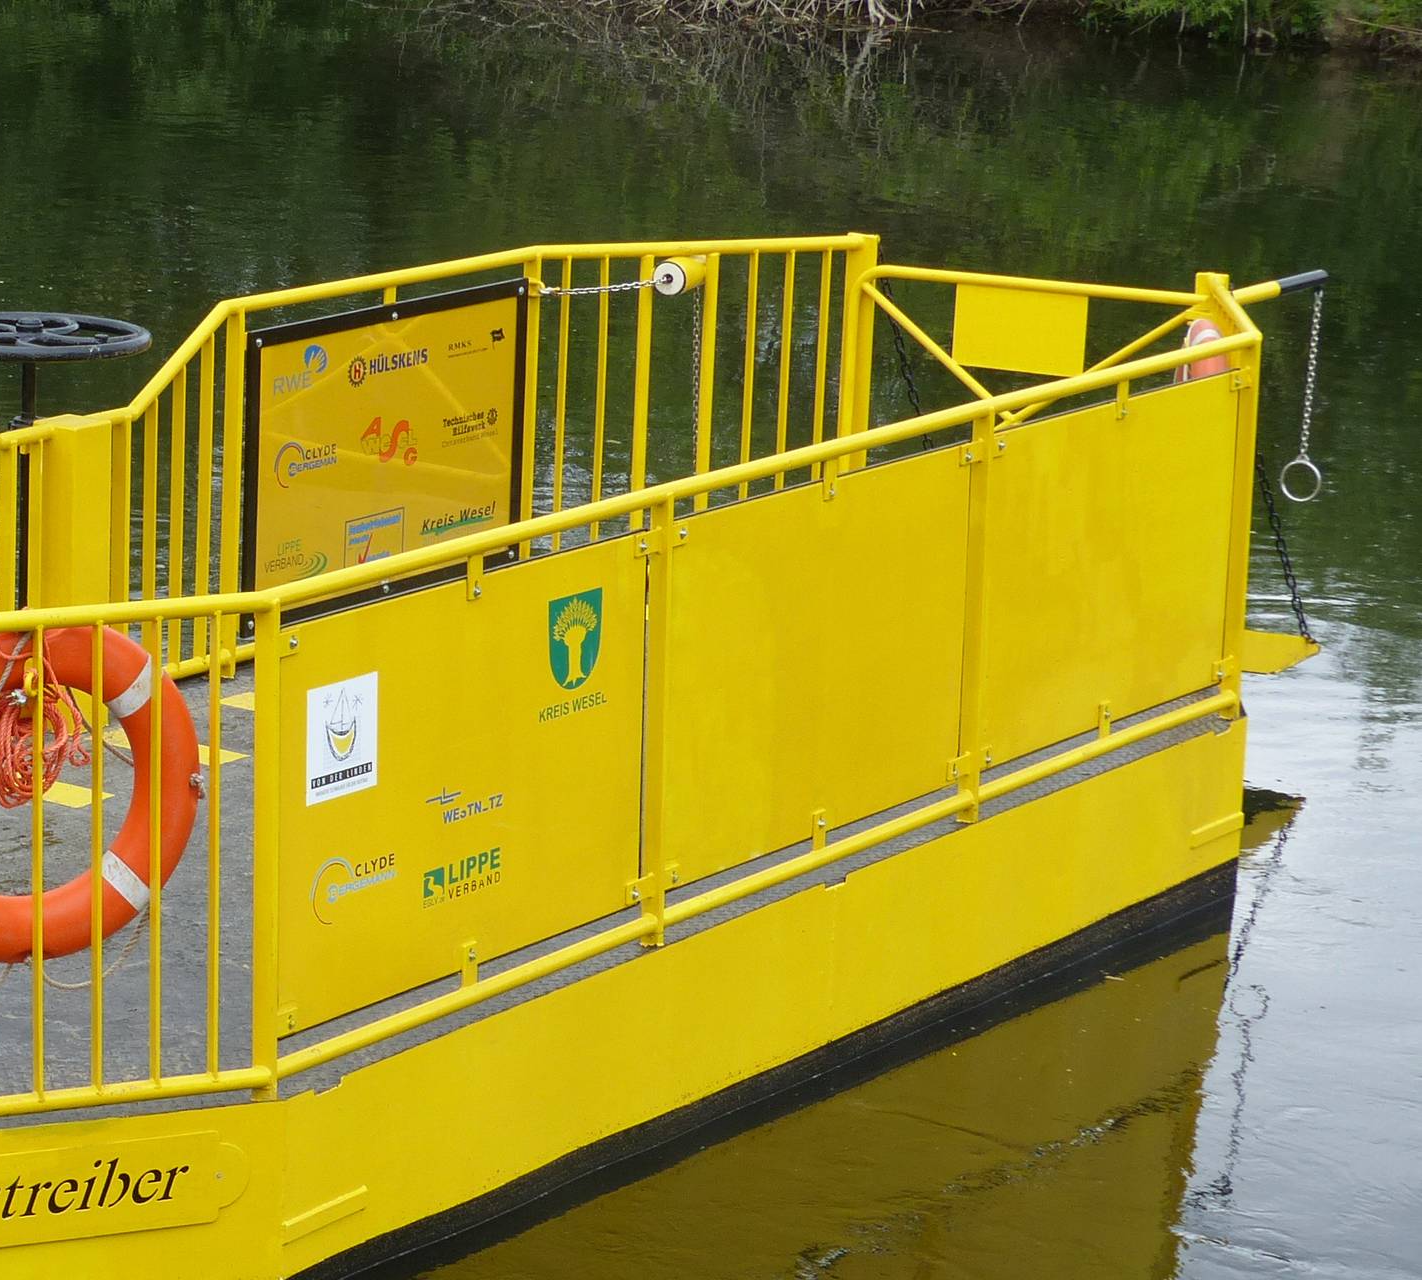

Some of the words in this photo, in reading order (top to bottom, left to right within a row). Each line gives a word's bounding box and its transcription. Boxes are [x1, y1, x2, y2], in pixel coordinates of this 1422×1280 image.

[369, 348, 429, 375] HÜLSKENS
[273, 370, 312, 397] RWE
[305, 443, 337, 460] CLYDE
[422, 513, 455, 532] Kreis
[460, 500, 496, 521] Wesel
[277, 539, 302, 556] LIPPE
[264, 553, 304, 573] VERBAND
[539, 702, 569, 723] KREIS
[572, 692, 607, 712] WESEL
[355, 853, 395, 877] CLYDE
[448, 847, 500, 885] LIPPE
[448, 871, 501, 899] VERBAND
